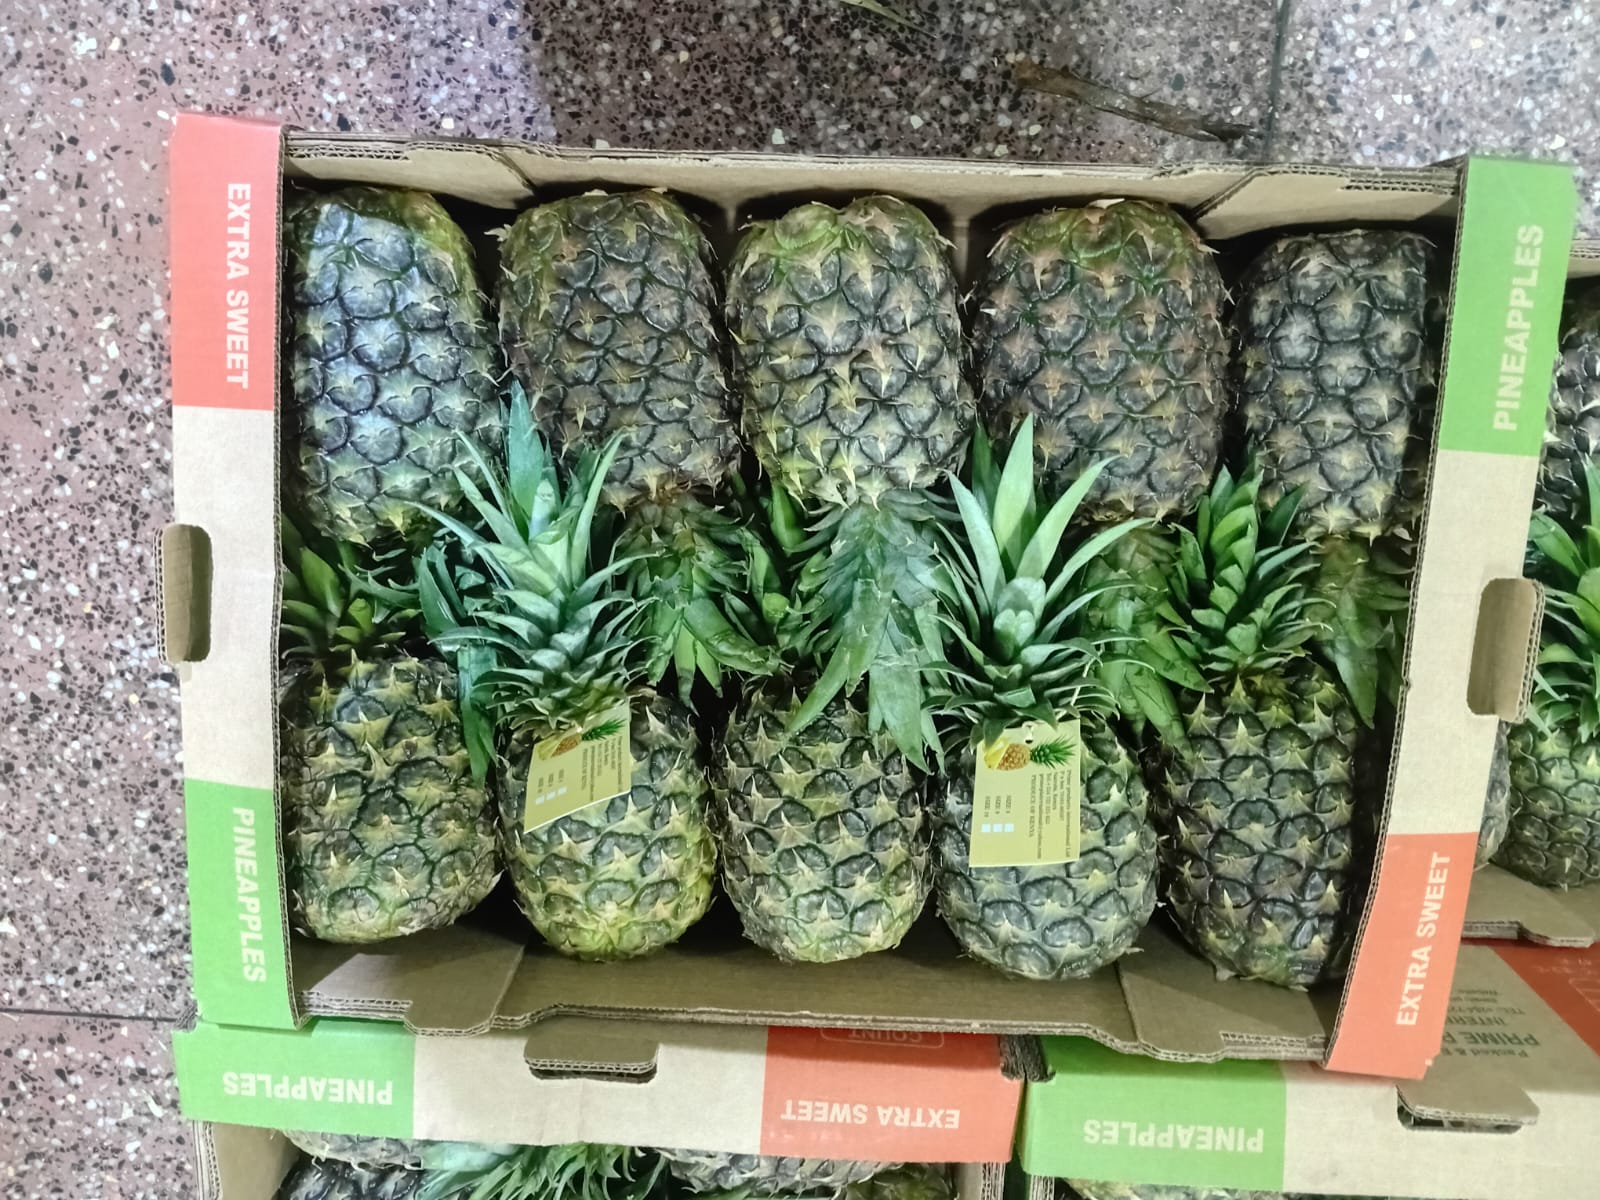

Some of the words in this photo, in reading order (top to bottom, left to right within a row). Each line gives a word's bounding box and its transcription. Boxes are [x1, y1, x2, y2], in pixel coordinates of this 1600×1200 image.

[226, 183, 251, 280] EXTRA
[226, 289, 249, 389] SWEET
[1493, 224, 1544, 431] PINEAPPLES
[232, 807, 267, 983] PINEAPPLES
[1396, 945, 1432, 1026] EXTRA
[1416, 851, 1451, 938] SWEET
[1458, 1031, 1541, 1047] PRIME
[222, 1071, 393, 1106] PINEAPPLES
[780, 1099, 868, 1124] SWEET
[876, 1106, 961, 1129] EXTRA
[1083, 1118, 1265, 1153] PINEAPPLES
